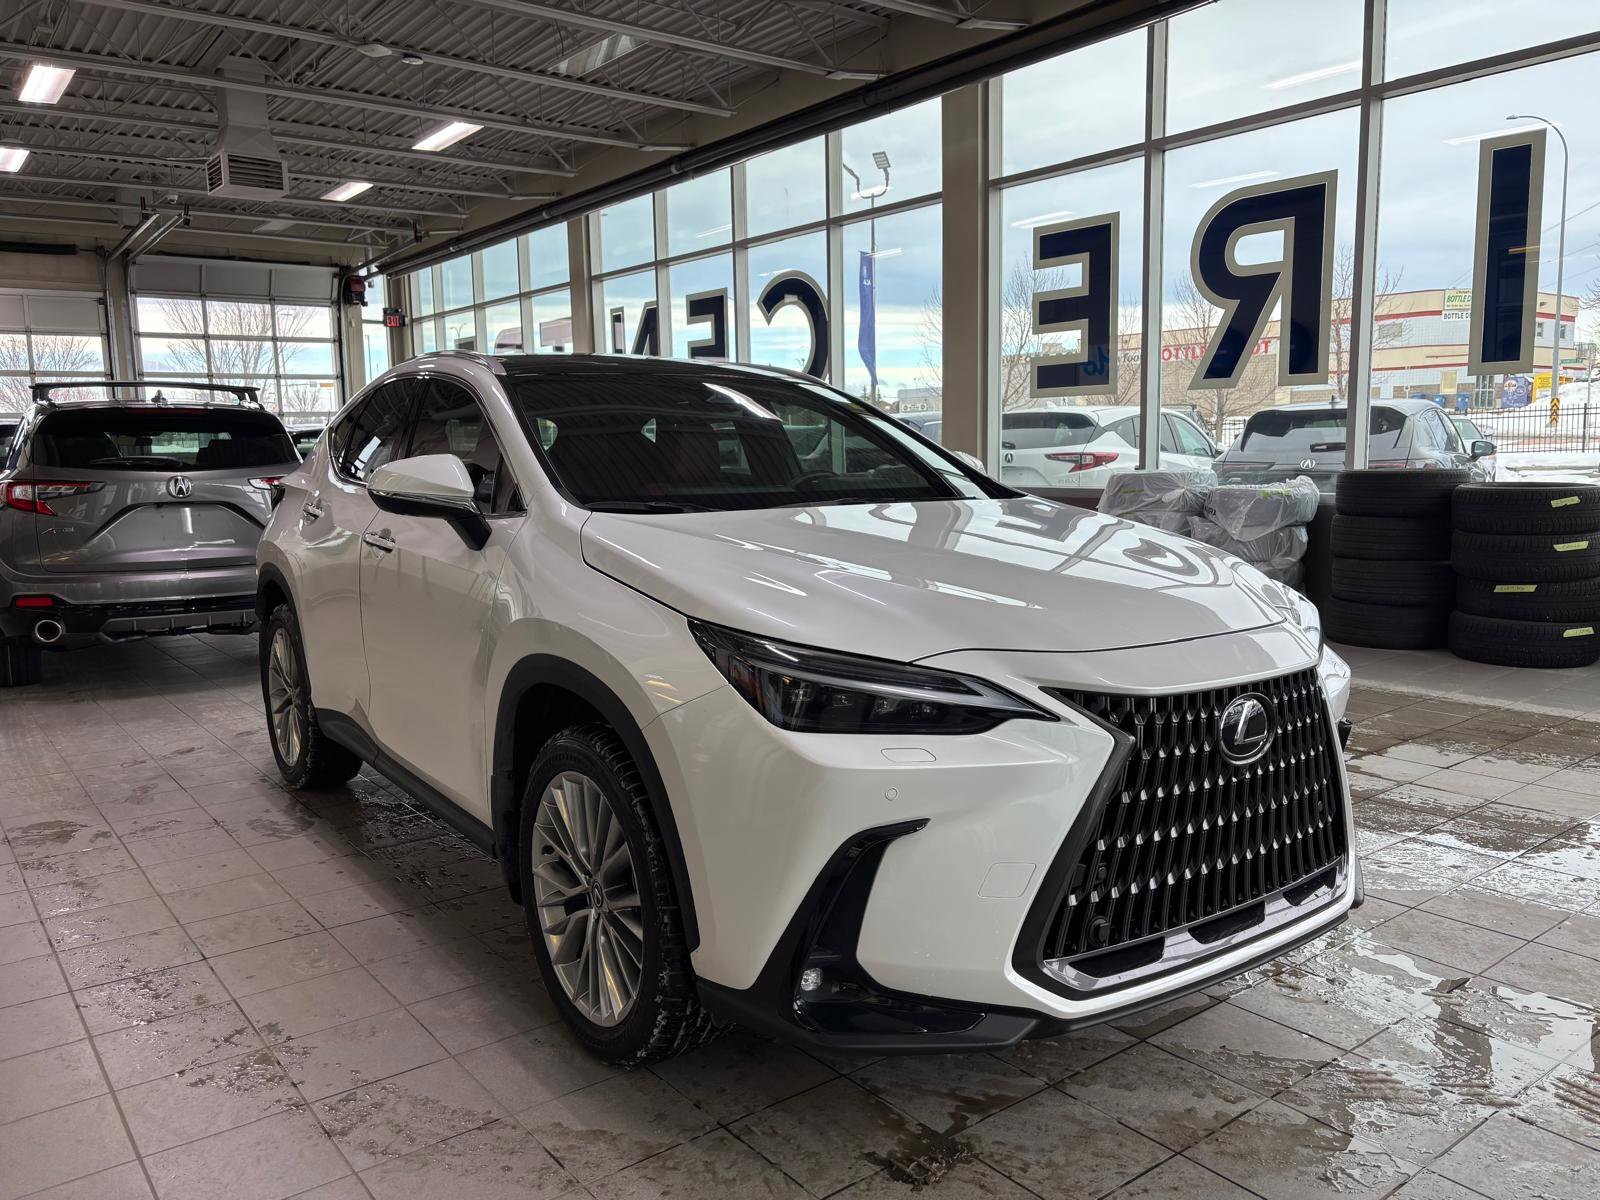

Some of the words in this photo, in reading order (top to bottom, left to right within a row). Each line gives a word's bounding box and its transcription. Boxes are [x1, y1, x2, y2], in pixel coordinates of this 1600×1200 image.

[1446, 294, 1467, 303] BOTTLE
[386, 315, 400, 327] EXIT
[1443, 312, 1464, 320] BOTTLE
[1161, 344, 1206, 361] OTTLE
